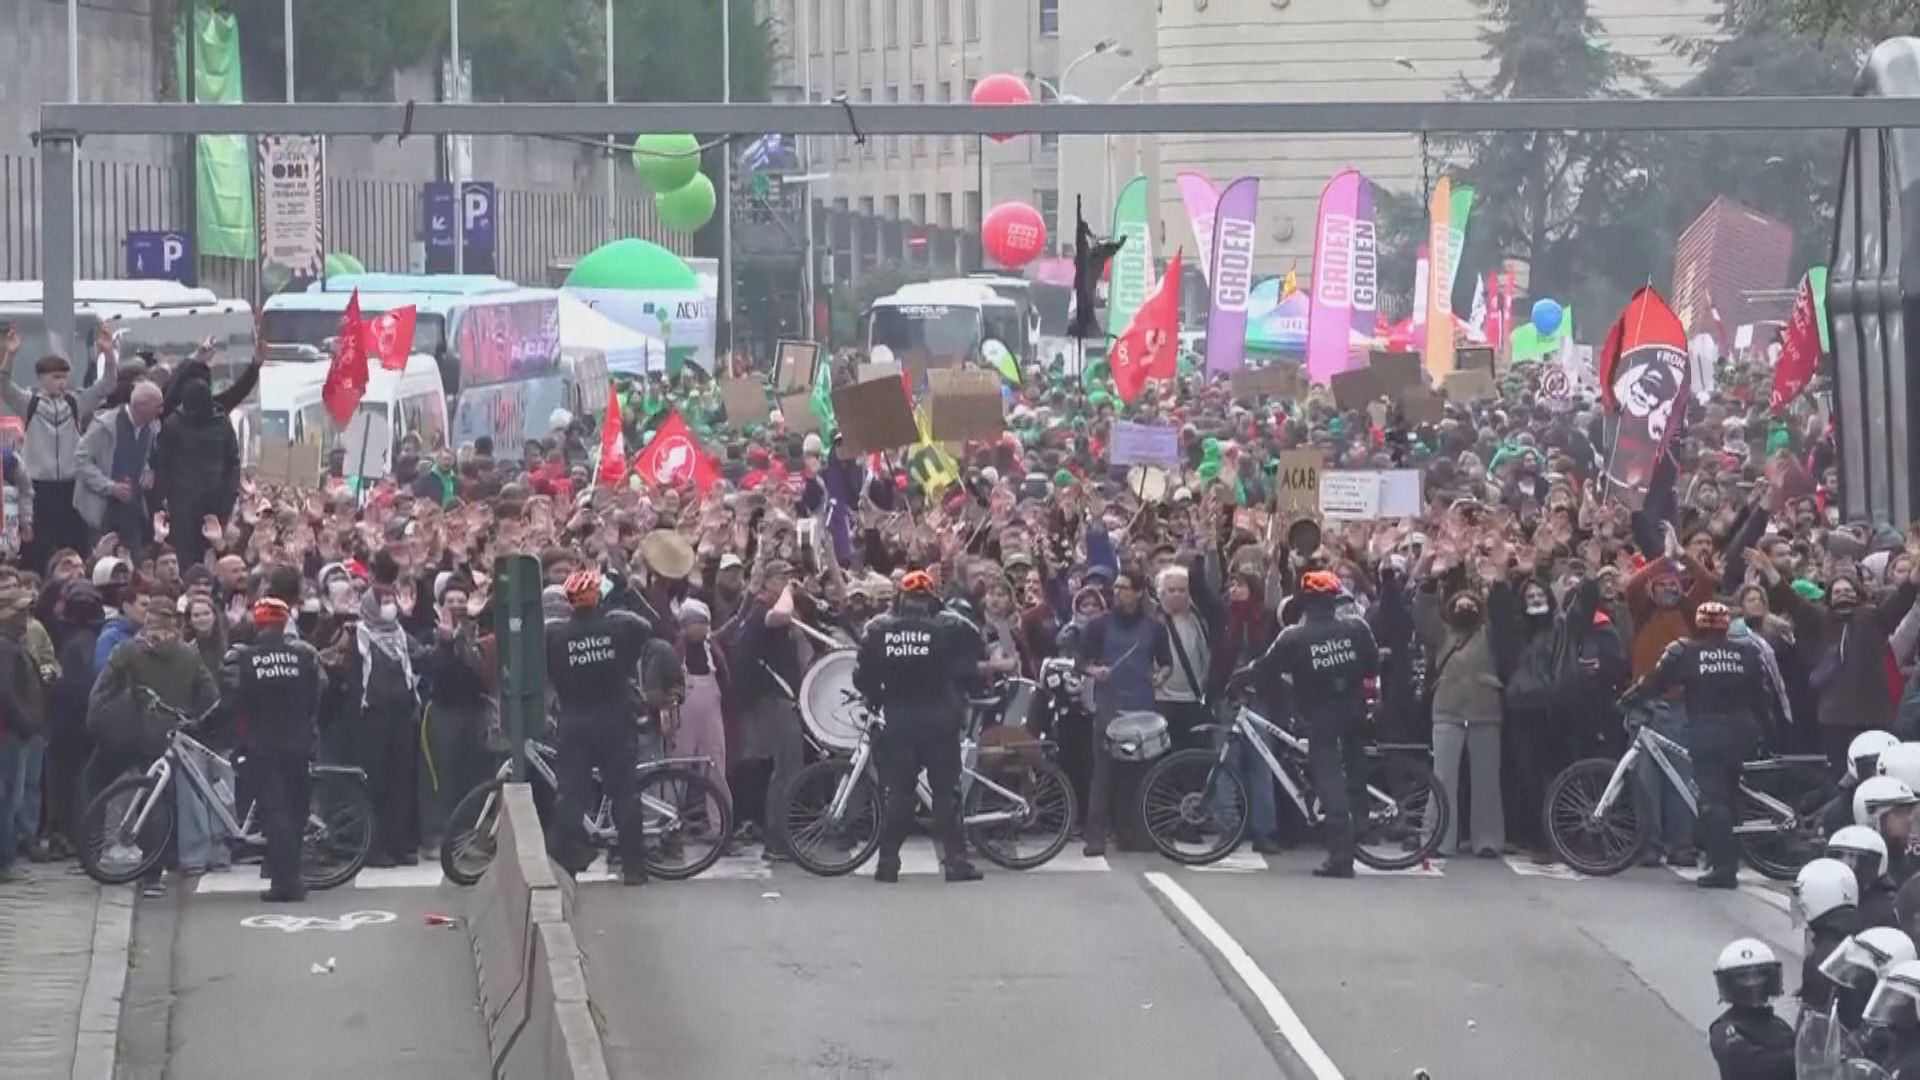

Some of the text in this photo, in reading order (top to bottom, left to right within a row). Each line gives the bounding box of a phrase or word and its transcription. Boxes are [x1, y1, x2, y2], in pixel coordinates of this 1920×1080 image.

[465, 193, 488, 230] P
[163, 240, 183, 272] P
[1219, 222, 1251, 306] GROEN
[1322, 218, 1350, 302] GROEN
[1354, 223, 1375, 306] GROEN
[1281, 466, 1316, 491] ACAB
[568, 636, 611, 653] Police
[885, 630, 931, 644] Politie
[886, 643, 929, 657] Police
[1310, 638, 1353, 657] Police
[1699, 648, 1741, 662] Police
[252, 651, 298, 667] Politie
[569, 648, 615, 667] Politie
[1312, 650, 1357, 670] Politie
[256, 664, 299, 680] Police
[1699, 661, 1744, 675] Politie
